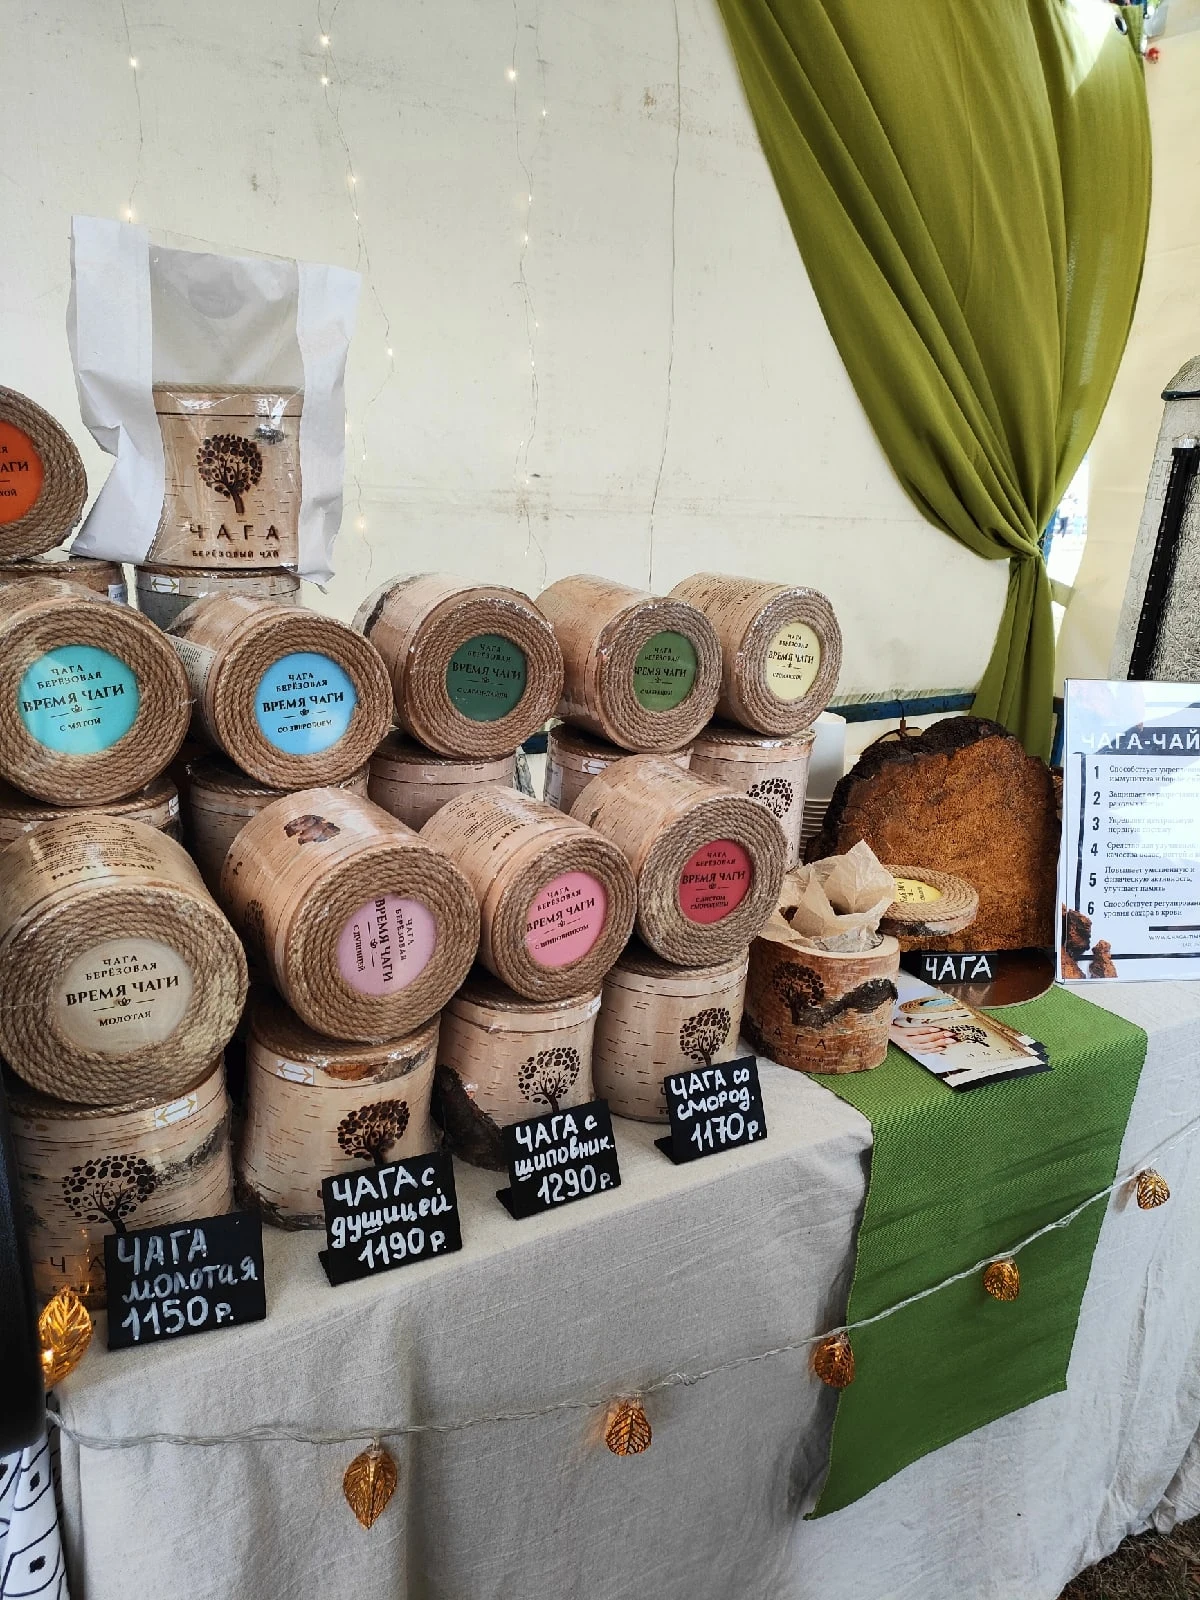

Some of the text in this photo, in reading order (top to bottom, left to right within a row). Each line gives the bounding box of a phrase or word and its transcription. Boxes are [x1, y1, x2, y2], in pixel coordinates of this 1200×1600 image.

[0, 461, 29, 472] АГИ
[189, 524, 280, 541] ЧАГА
[259, 549, 279, 559] ЧАЙ
[481, 643, 501, 653] ЧАГА
[768, 650, 794, 661] ВРЕМЯ
[51, 664, 84, 676] ЧАГА
[288, 672, 314, 681] ЧАГА
[452, 662, 522, 680] ВРЕМЯ ЧАГИ
[663, 668, 687, 677] ЧАГИ
[22, 683, 125, 713] ВРЕМЯ ЧАГИ
[262, 691, 344, 713] ВРЕМЯ ЧАГИ
[59, 717, 102, 732] С МЯТОЙ
[1094, 765, 1099, 780] 1
[1093, 790, 1101, 806] 2
[1092, 816, 1100, 831] 3
[707, 851, 728, 859] ЧАГА
[1090, 842, 1099, 857] 4
[681, 870, 746, 885] ВРЕМЯ ЧАГИ
[1089, 872, 1097, 888] 5
[547, 886, 570, 899] ЧАГА
[526, 897, 596, 933] ВРЕМЯ ЧАГИ
[1087, 900, 1095, 916] 6
[405, 917, 415, 946] ЧАГА
[374, 898, 394, 983] ВРЕМЯ ЧАГИ
[102, 955, 138, 967] ЧАГА
[925, 955, 992, 981] ЧАГА
[65, 975, 180, 1007] ВРЕМЯ ЧАГИ
[98, 1010, 152, 1027] МОЛОТАЯ
[670, 1069, 727, 1100] ЧАГА
[515, 1113, 579, 1152] ЧАГА
[331, 1165, 419, 1207] ЧАГА
[117, 1228, 208, 1276] ЧАГА
